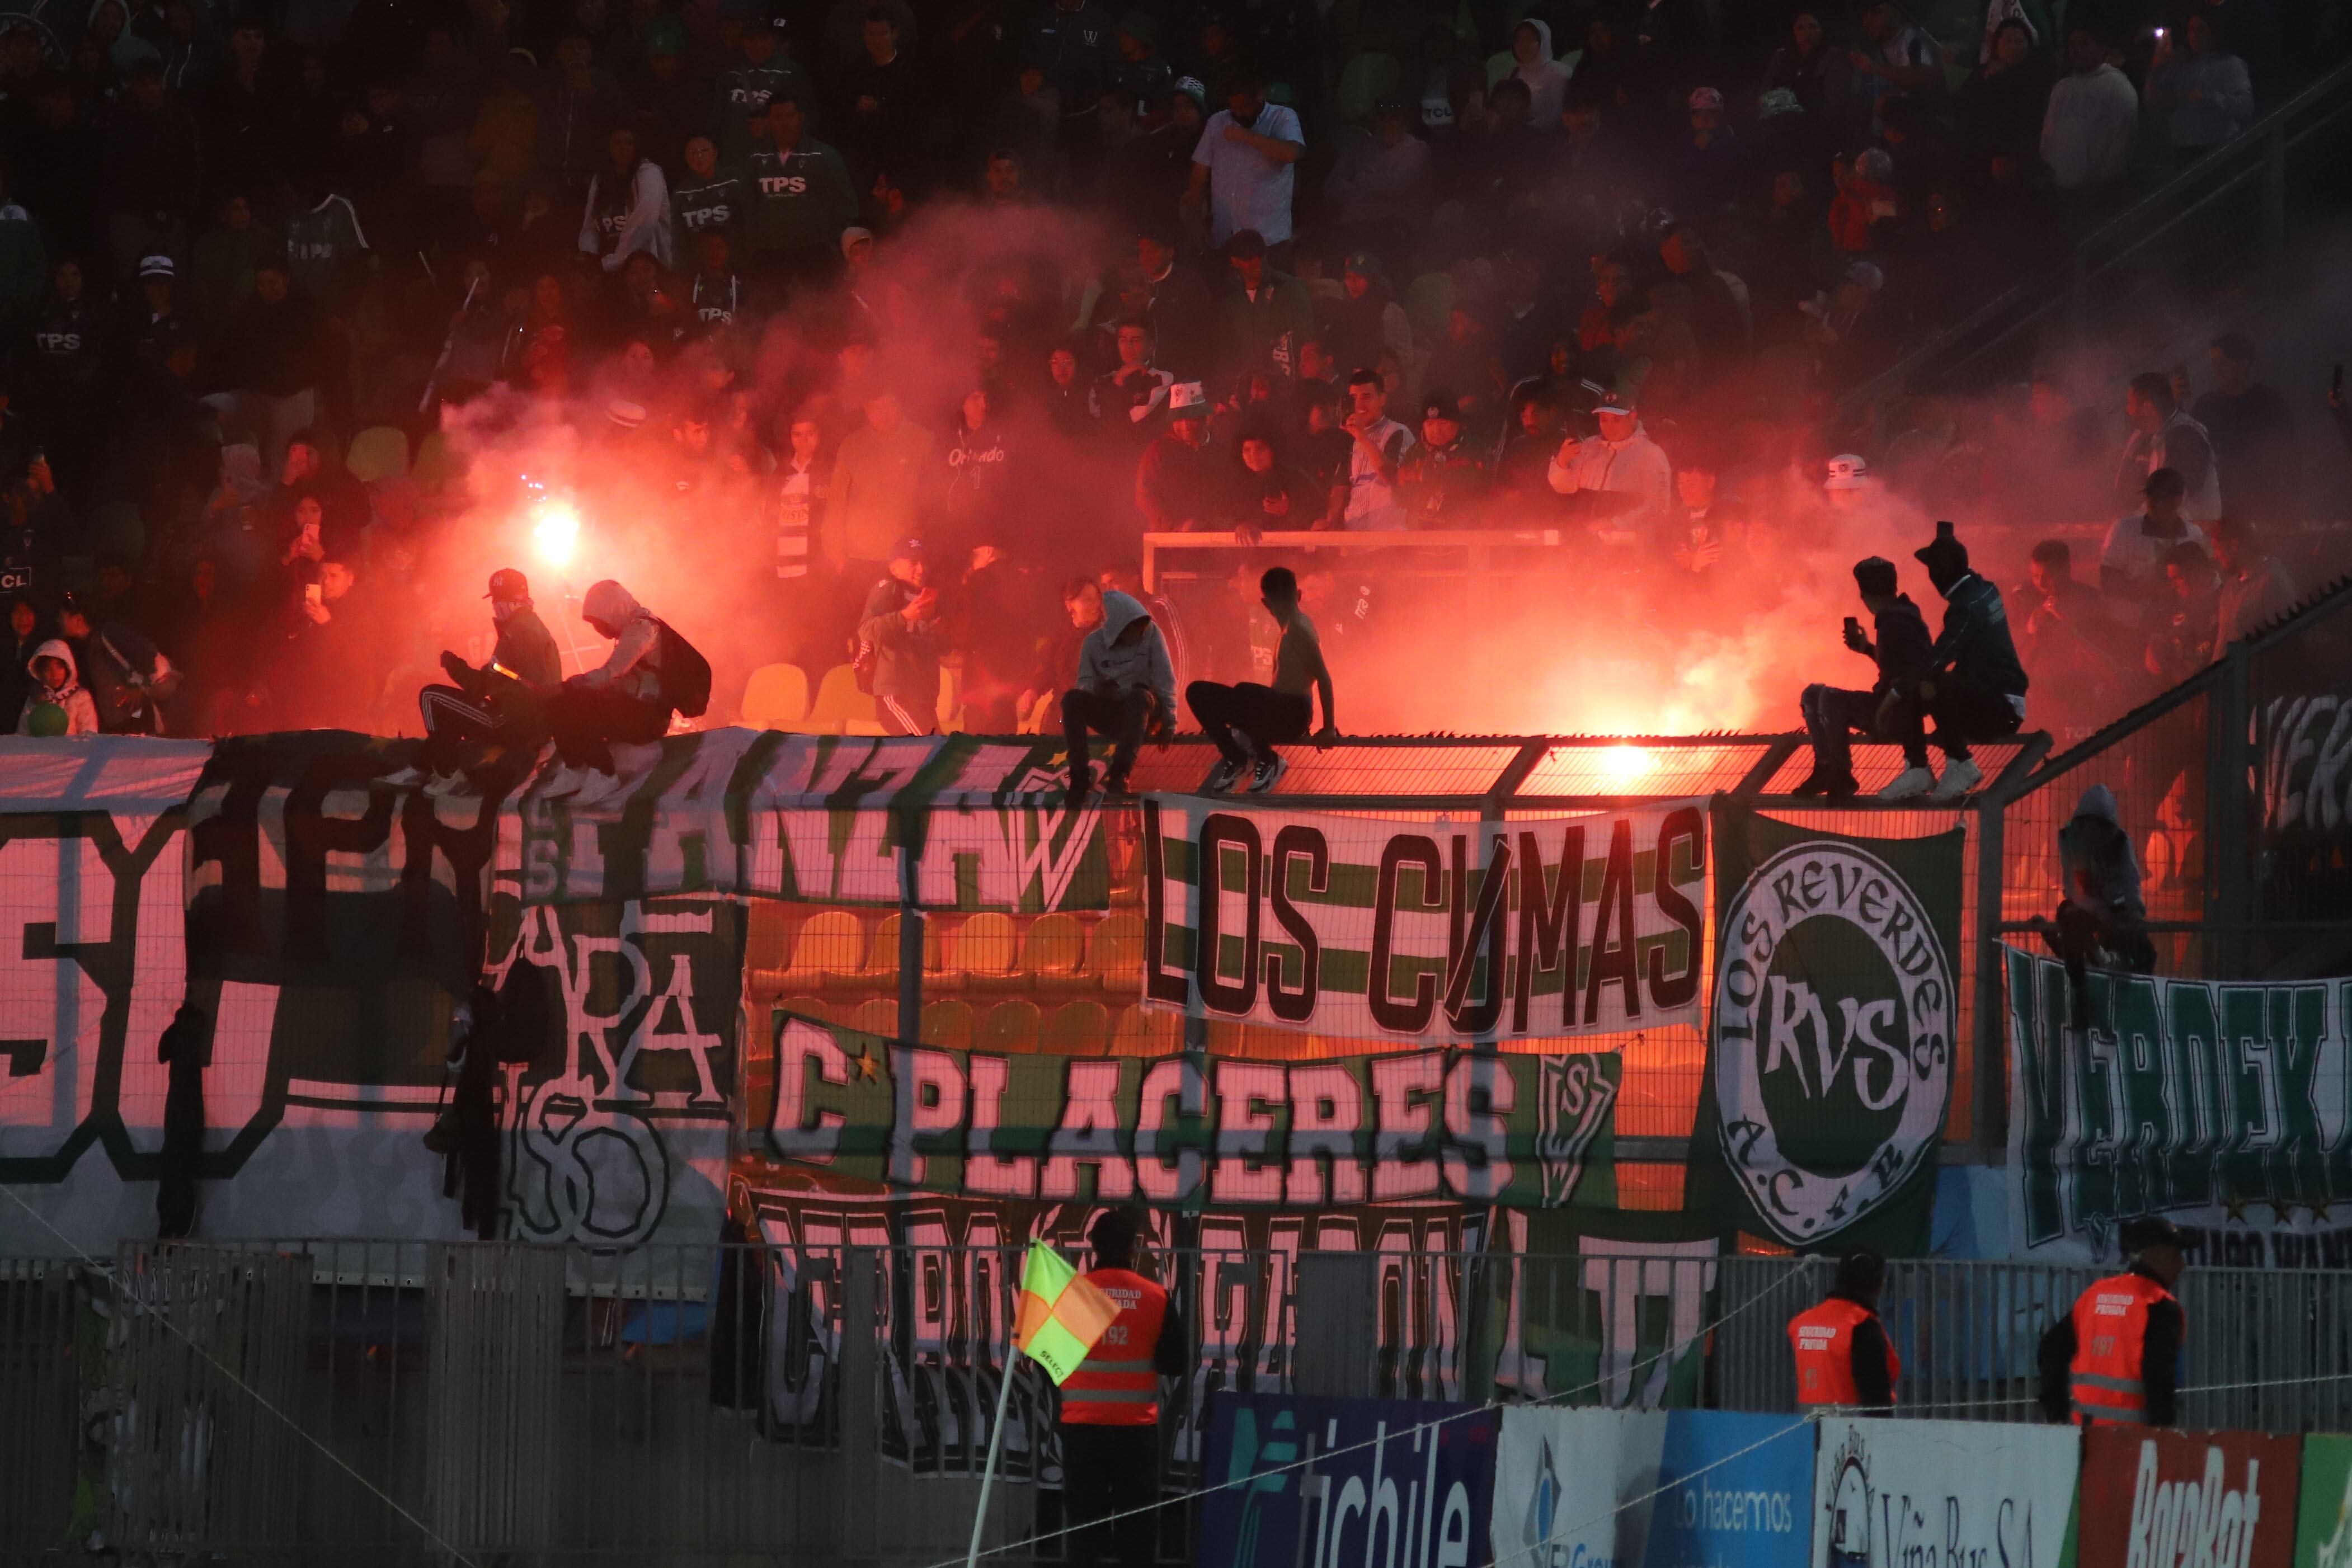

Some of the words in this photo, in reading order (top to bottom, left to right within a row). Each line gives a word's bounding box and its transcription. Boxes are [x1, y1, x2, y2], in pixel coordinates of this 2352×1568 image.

[759, 176, 806, 194] TPS
[601, 215, 625, 233] PS
[682, 205, 730, 228] TPS
[698, 308, 732, 325] TPS
[35, 332, 81, 350] TPS
[948, 446, 1004, 466] Orlndo
[1142, 798, 1329, 1023] LOS
[1720, 910, 1774, 1042] LOS
[1771, 859, 1946, 1082] REVERDES
[1763, 973, 1910, 1112] RVS
[887, 1043, 1518, 1204] PLACERES
[1100, 1288, 1142, 1299] URIDAD
[1039, 1350, 1064, 1378] SELECT
[1702, 1475, 1792, 1533] hacemos
